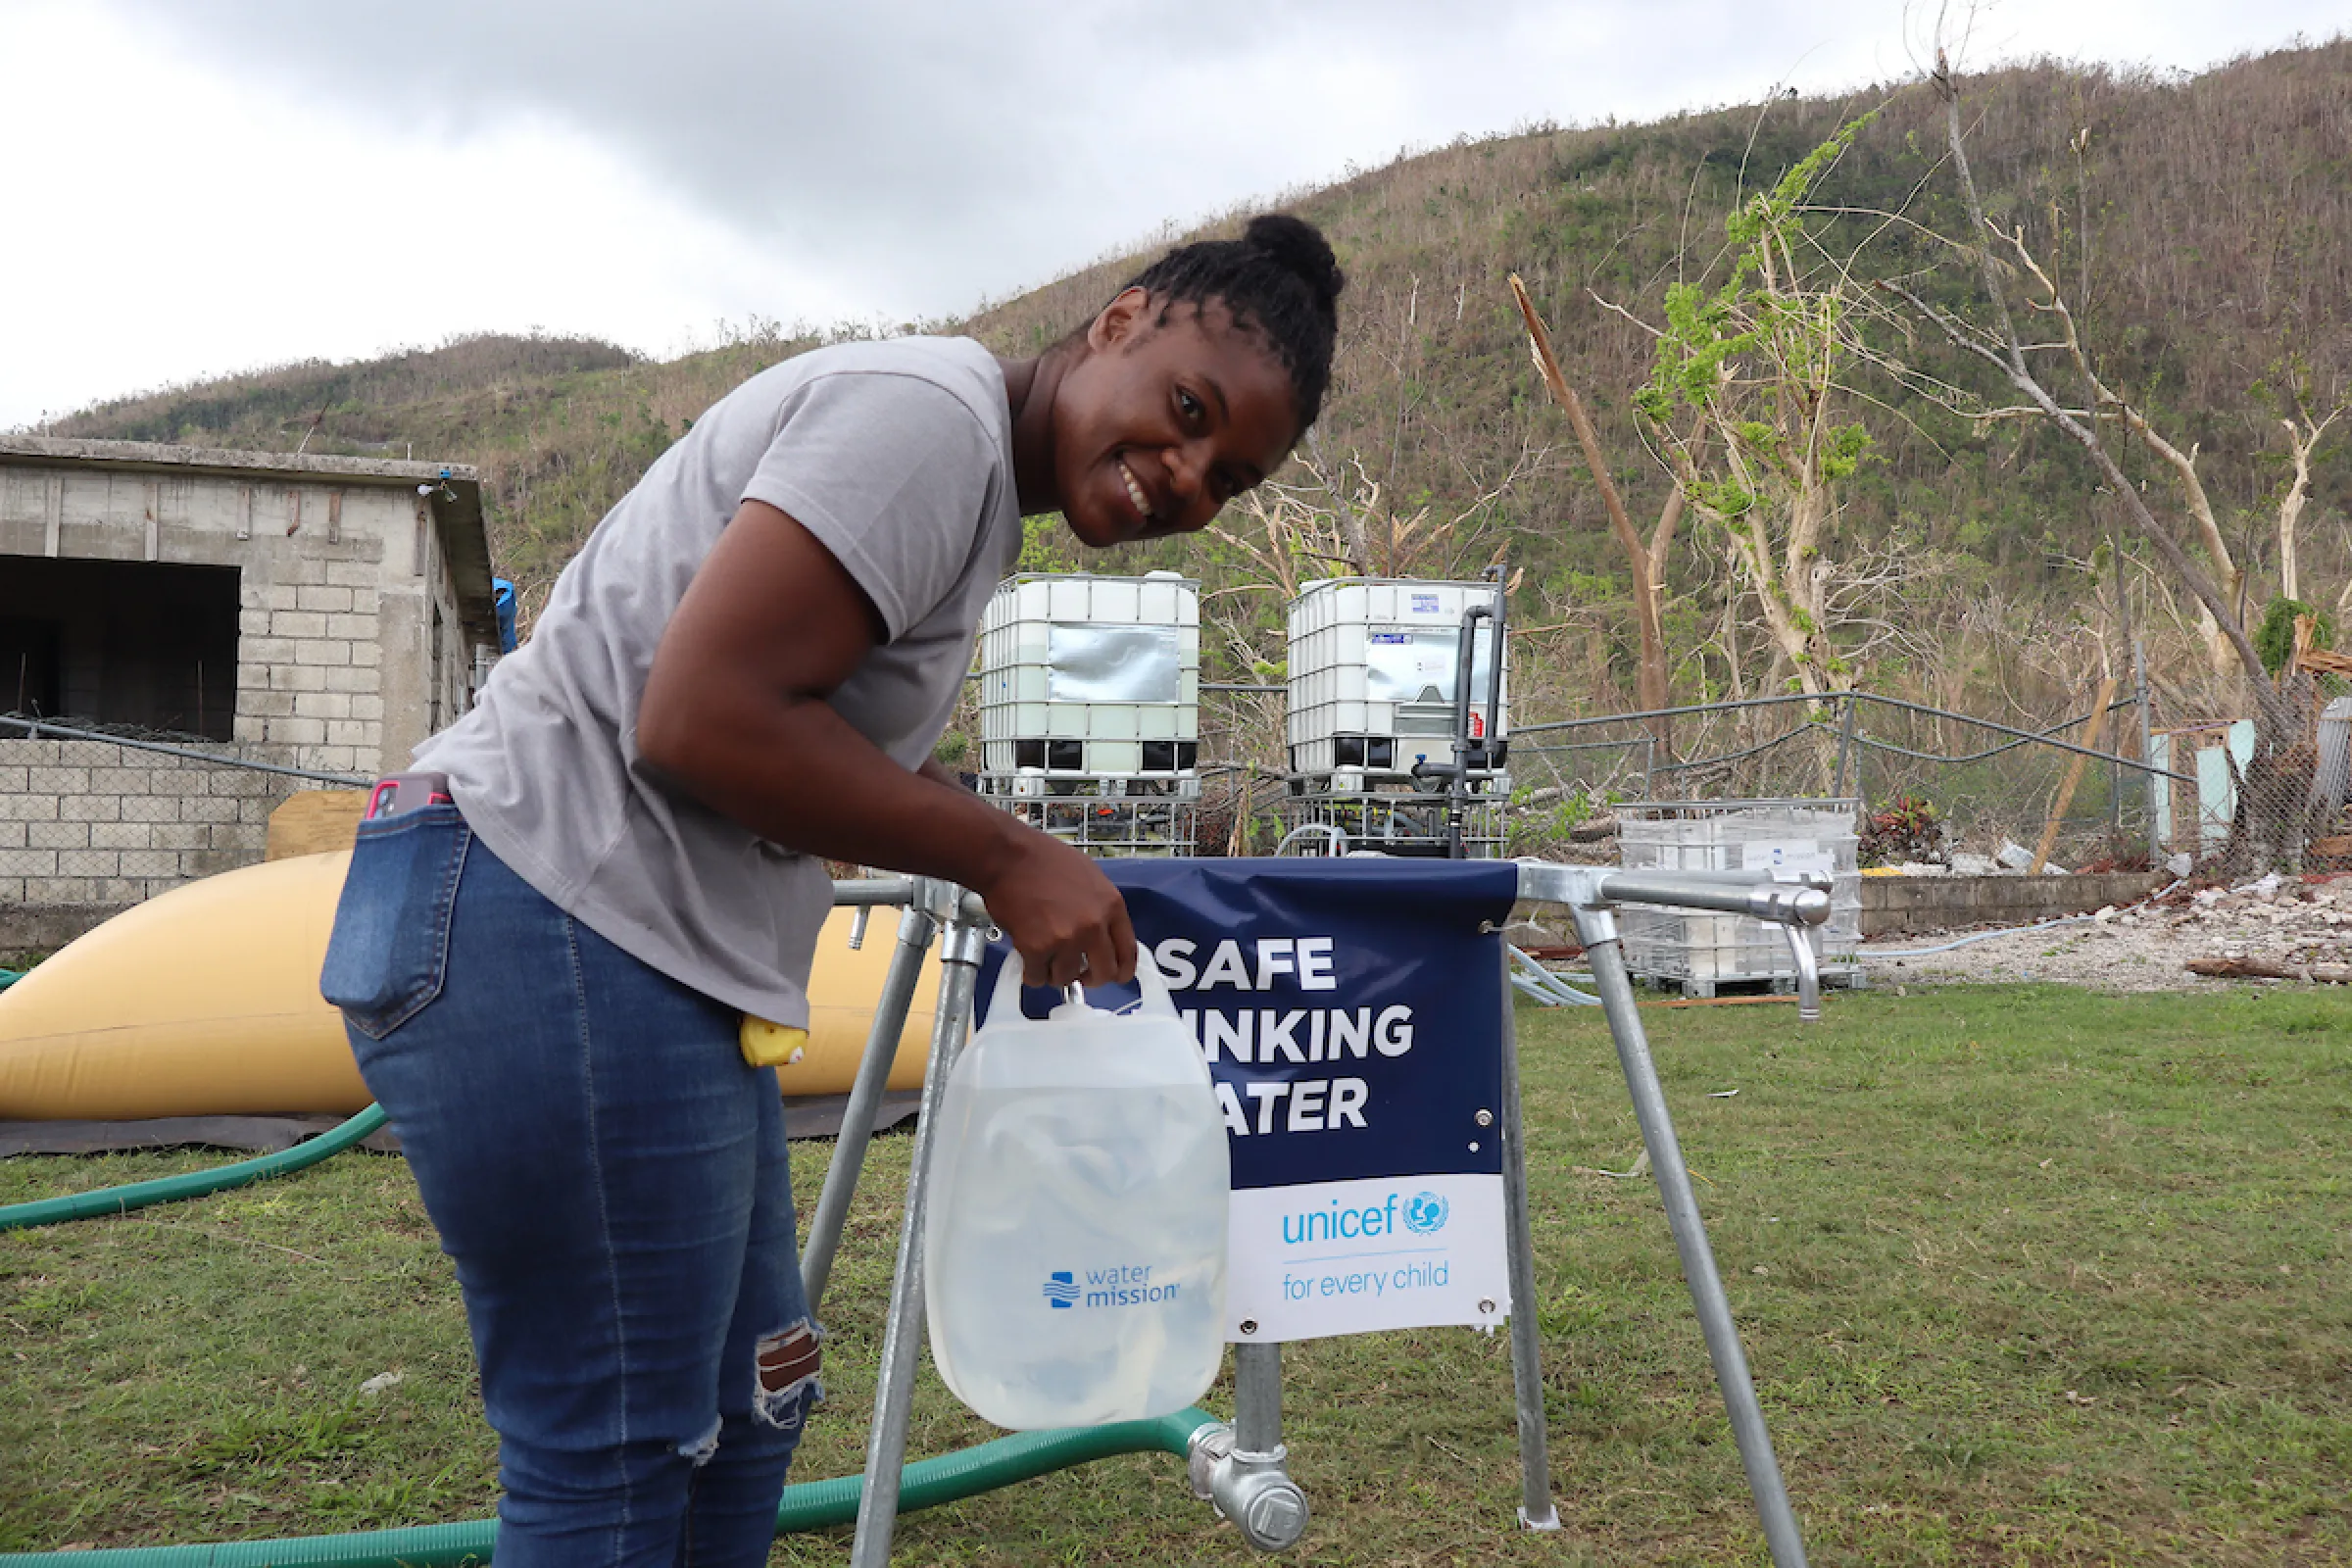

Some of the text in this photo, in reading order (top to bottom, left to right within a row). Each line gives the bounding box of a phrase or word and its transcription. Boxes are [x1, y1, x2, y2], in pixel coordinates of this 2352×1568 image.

[1154, 937, 1337, 991] SAFE
[1180, 1004, 1414, 1063] NKING
[1214, 1077, 1369, 1137] ATER
[1283, 1193, 1398, 1245] unicef
[1085, 1264, 1152, 1286] water
[1087, 1284, 1178, 1308] mission
[1283, 1259, 1450, 1300] for every child
